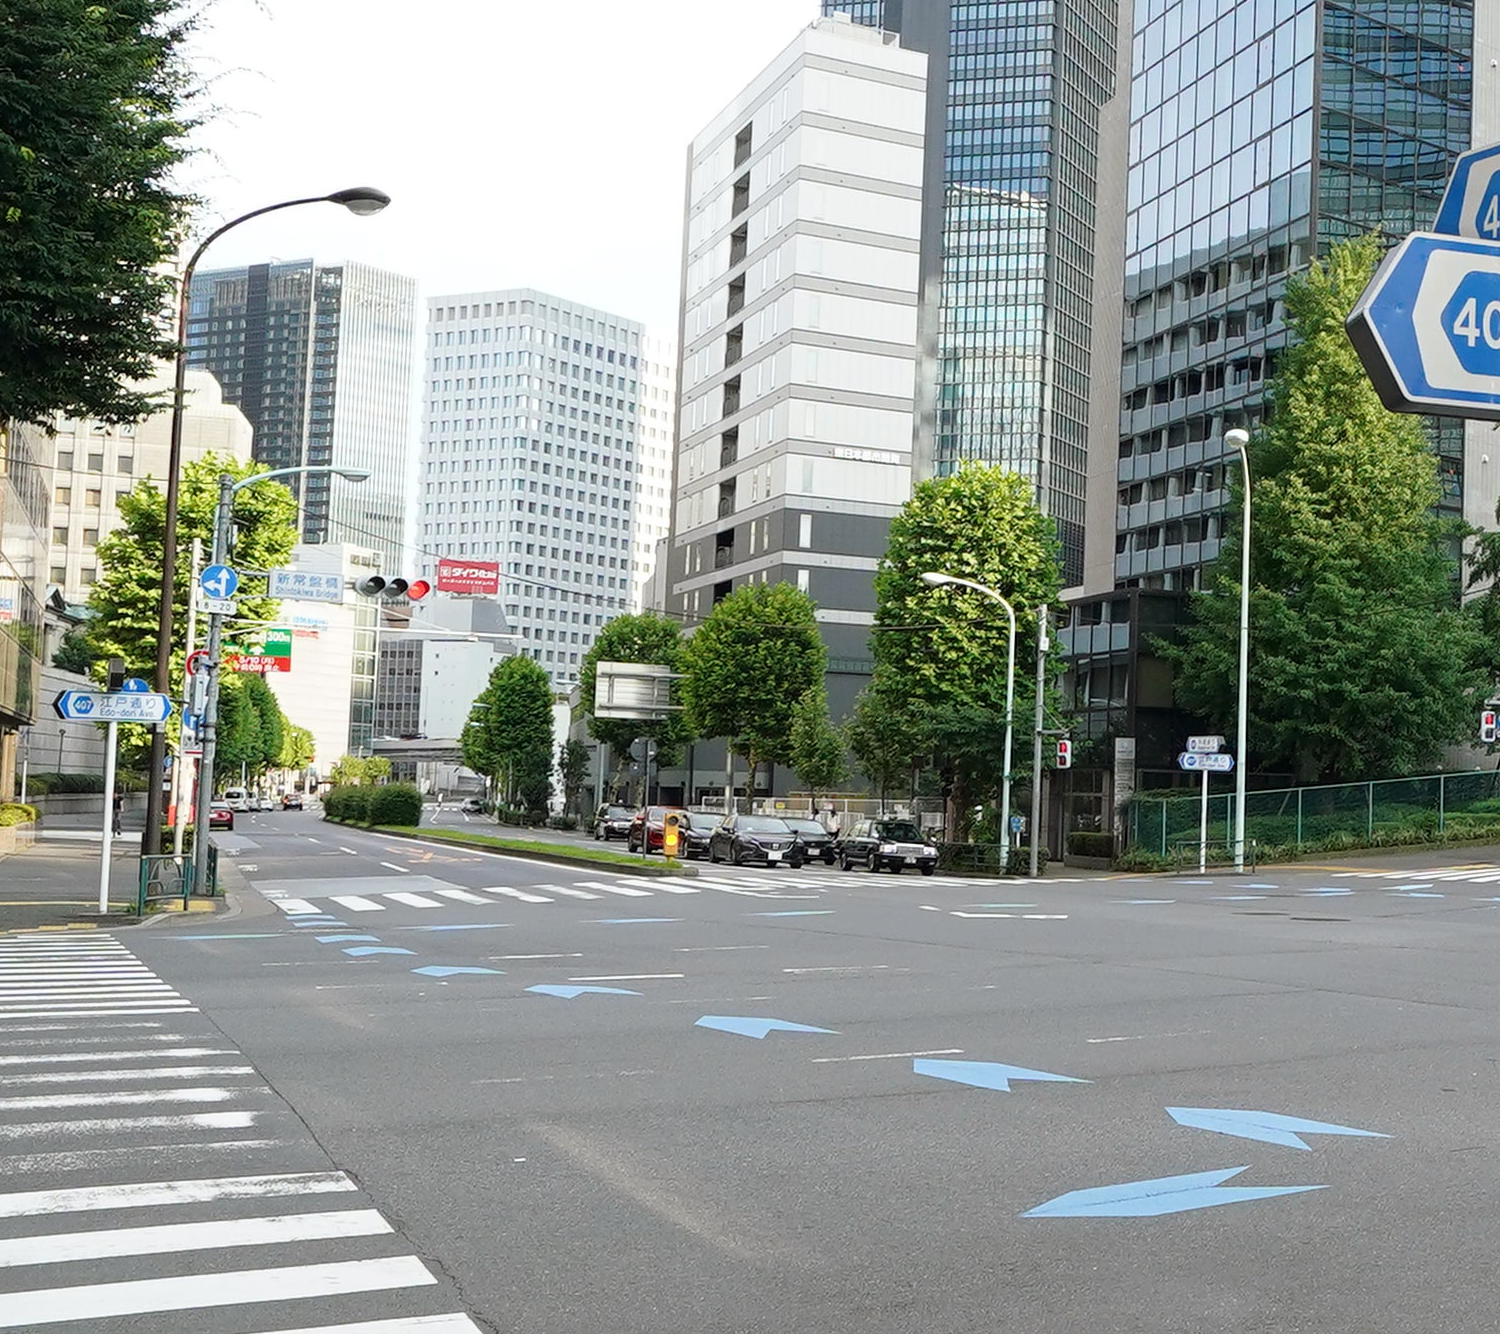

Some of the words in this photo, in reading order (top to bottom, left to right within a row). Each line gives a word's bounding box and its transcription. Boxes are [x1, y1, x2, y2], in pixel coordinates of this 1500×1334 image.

[276, 573, 339, 589] 新常盤橋
[316, 587, 339, 600] Bridge
[100, 696, 157, 709] 江戸通り
